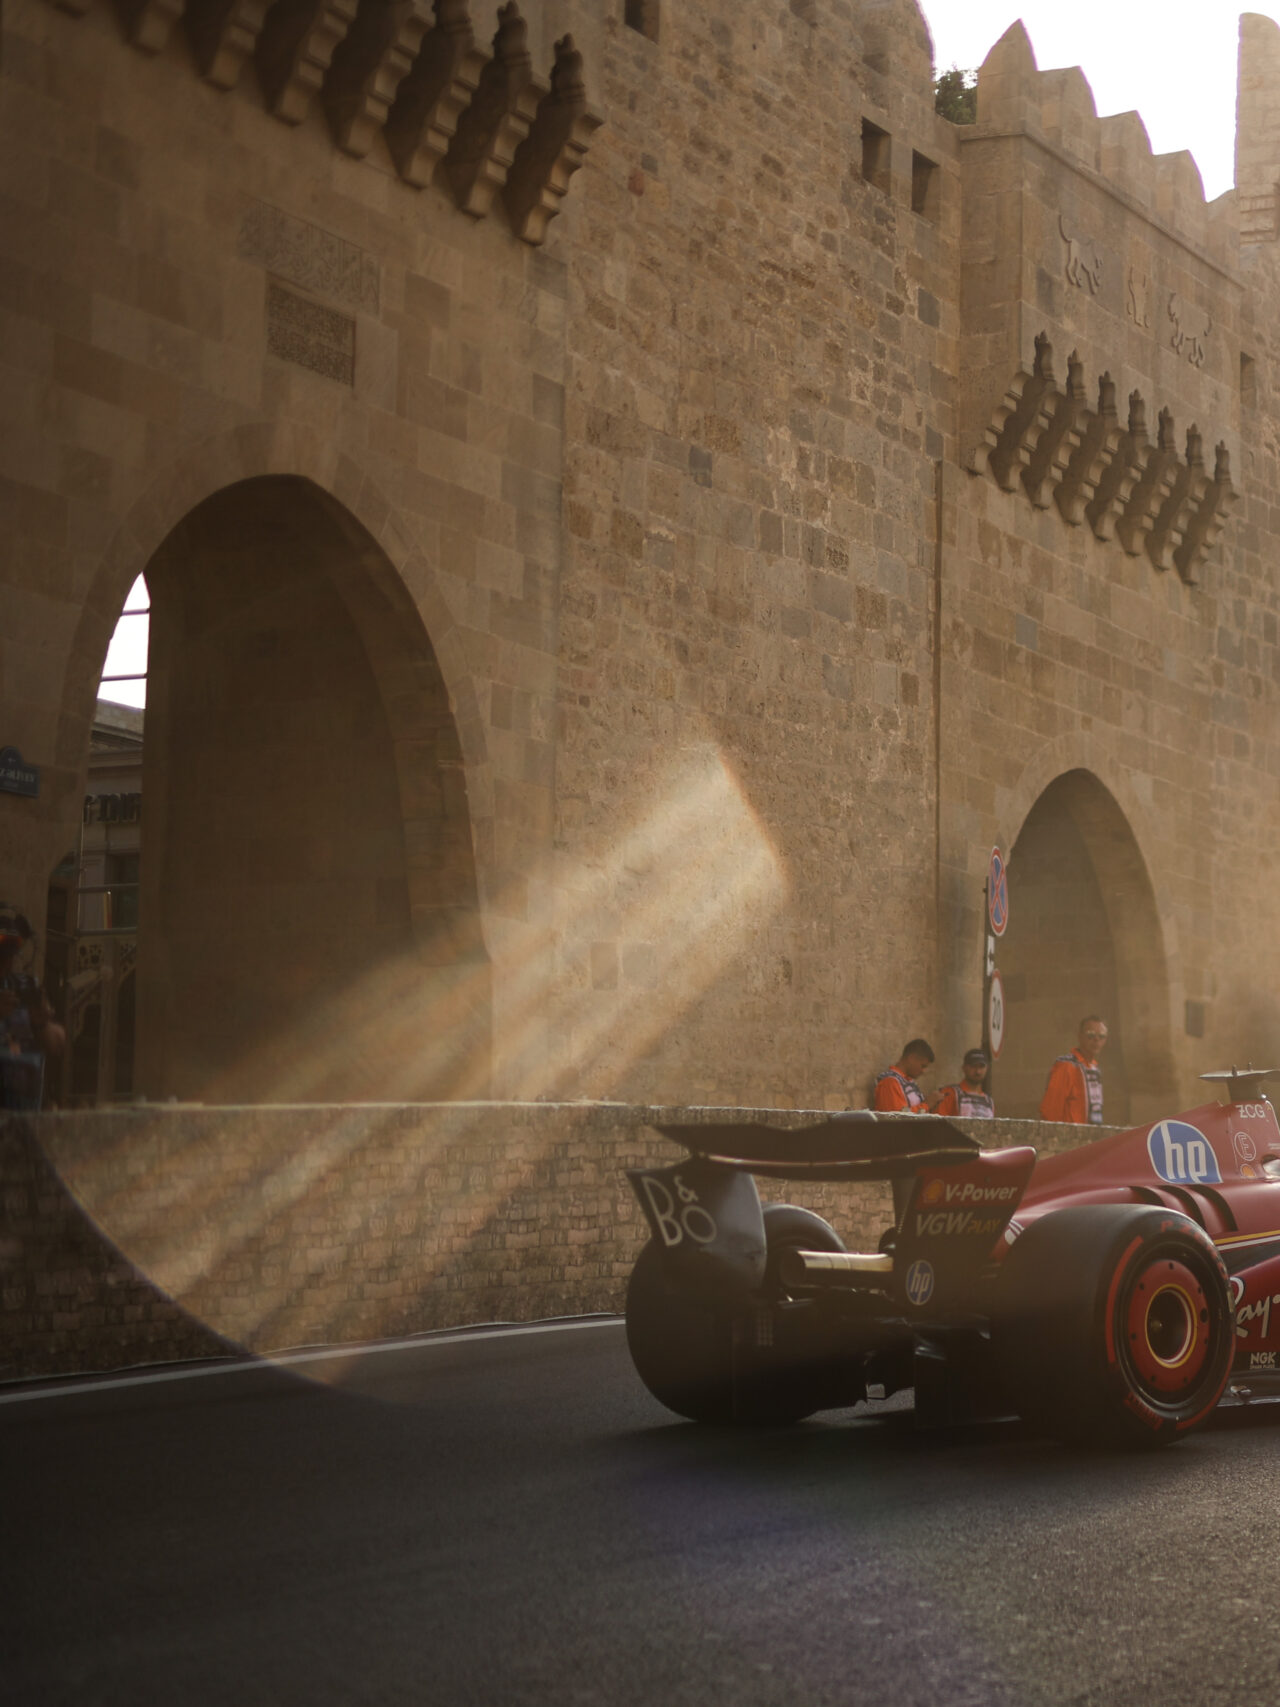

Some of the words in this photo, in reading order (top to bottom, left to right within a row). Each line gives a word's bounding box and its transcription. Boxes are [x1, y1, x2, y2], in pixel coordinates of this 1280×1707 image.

[1160, 1122, 1208, 1184] hp
[945, 1183, 1018, 1202] V-Power
[916, 1212, 973, 1237] VGW
[1250, 1352, 1276, 1364] NGK
